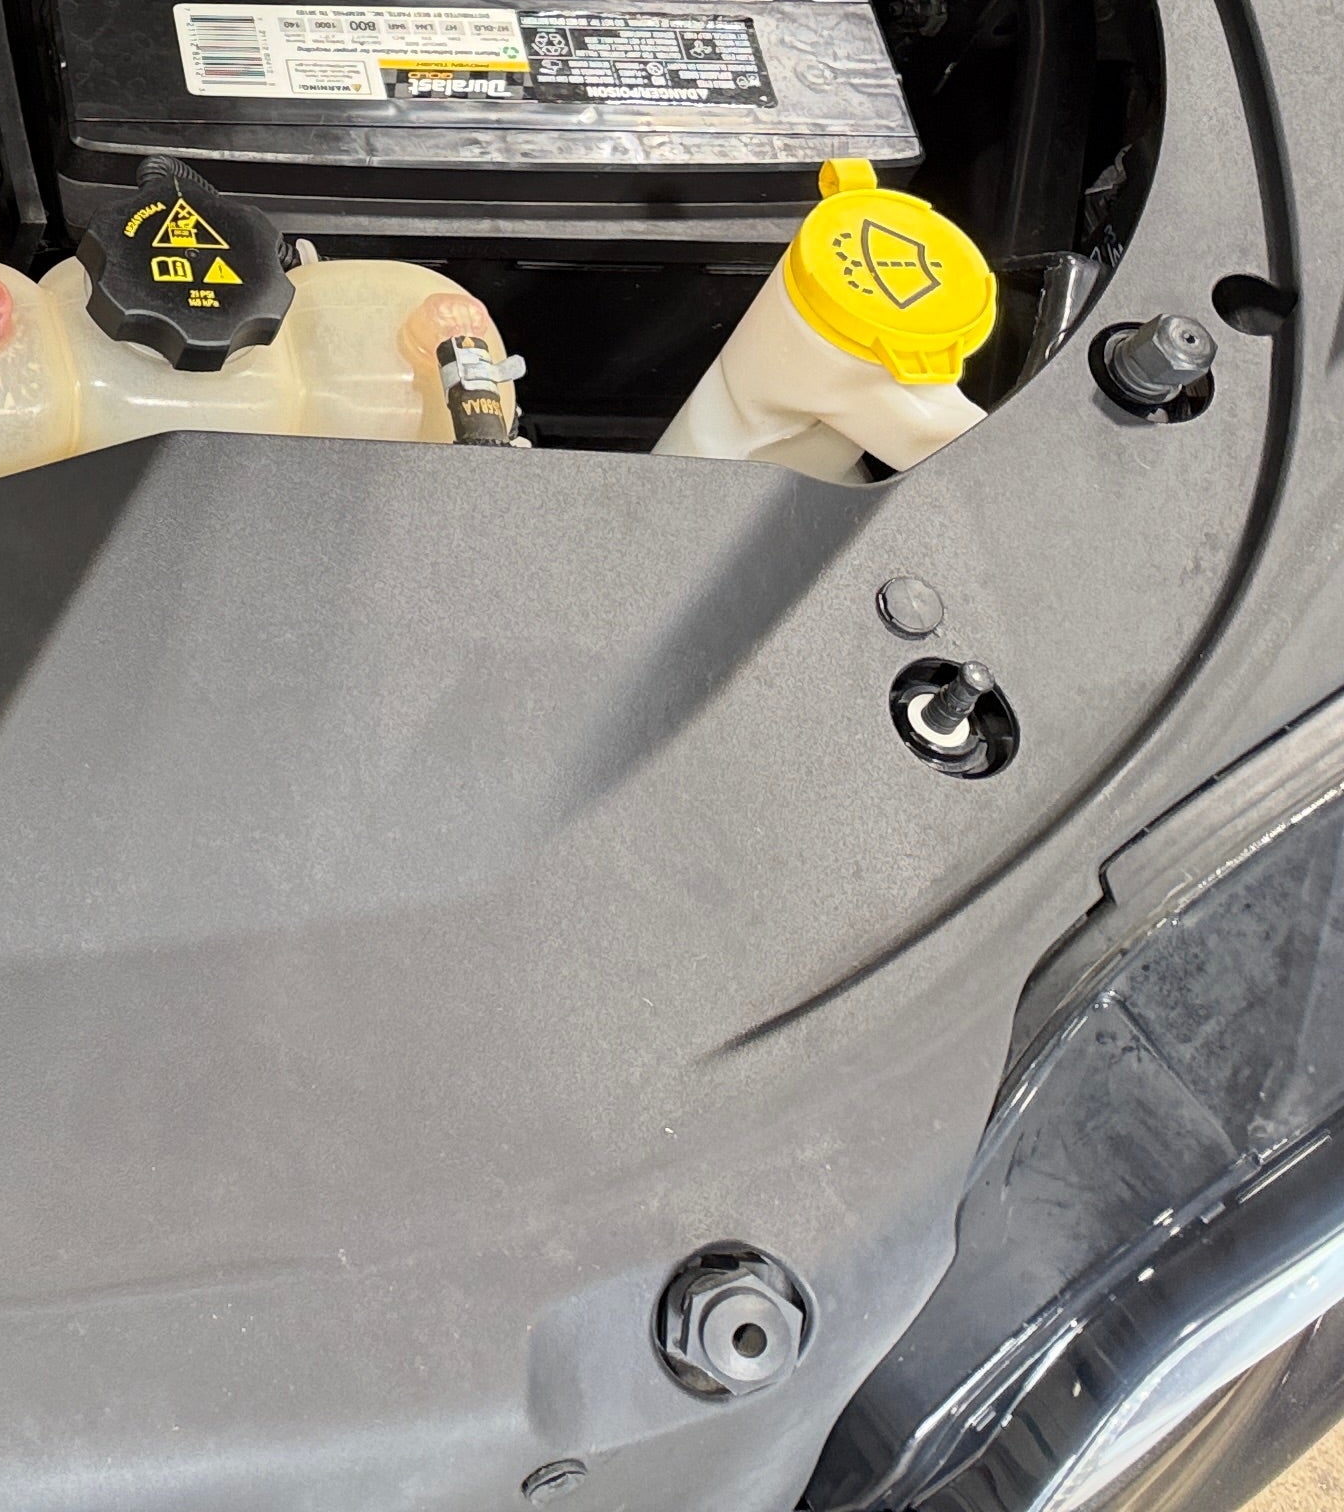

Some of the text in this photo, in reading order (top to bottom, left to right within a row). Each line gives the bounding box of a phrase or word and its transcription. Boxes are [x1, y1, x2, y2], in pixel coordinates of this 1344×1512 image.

[284, 21, 300, 29] 140
[314, 21, 337, 29] 1000
[349, 20, 377, 32] 800
[415, 23, 434, 32] LN4
[445, 24, 458, 32] H7
[473, 24, 510, 32] H7-DLG
[297, 46, 332, 54] recycling
[420, 49, 453, 57] batteries
[474, 50, 501, 58] Return
[450, 61, 490, 69] PROVEN
[408, 71, 454, 80] GOLD
[299, 84, 351, 92] WARNING:
[408, 78, 512, 97] Duralast
[585, 85, 700, 100] DANGER/POISON
[199, 289, 216, 299] PSI
